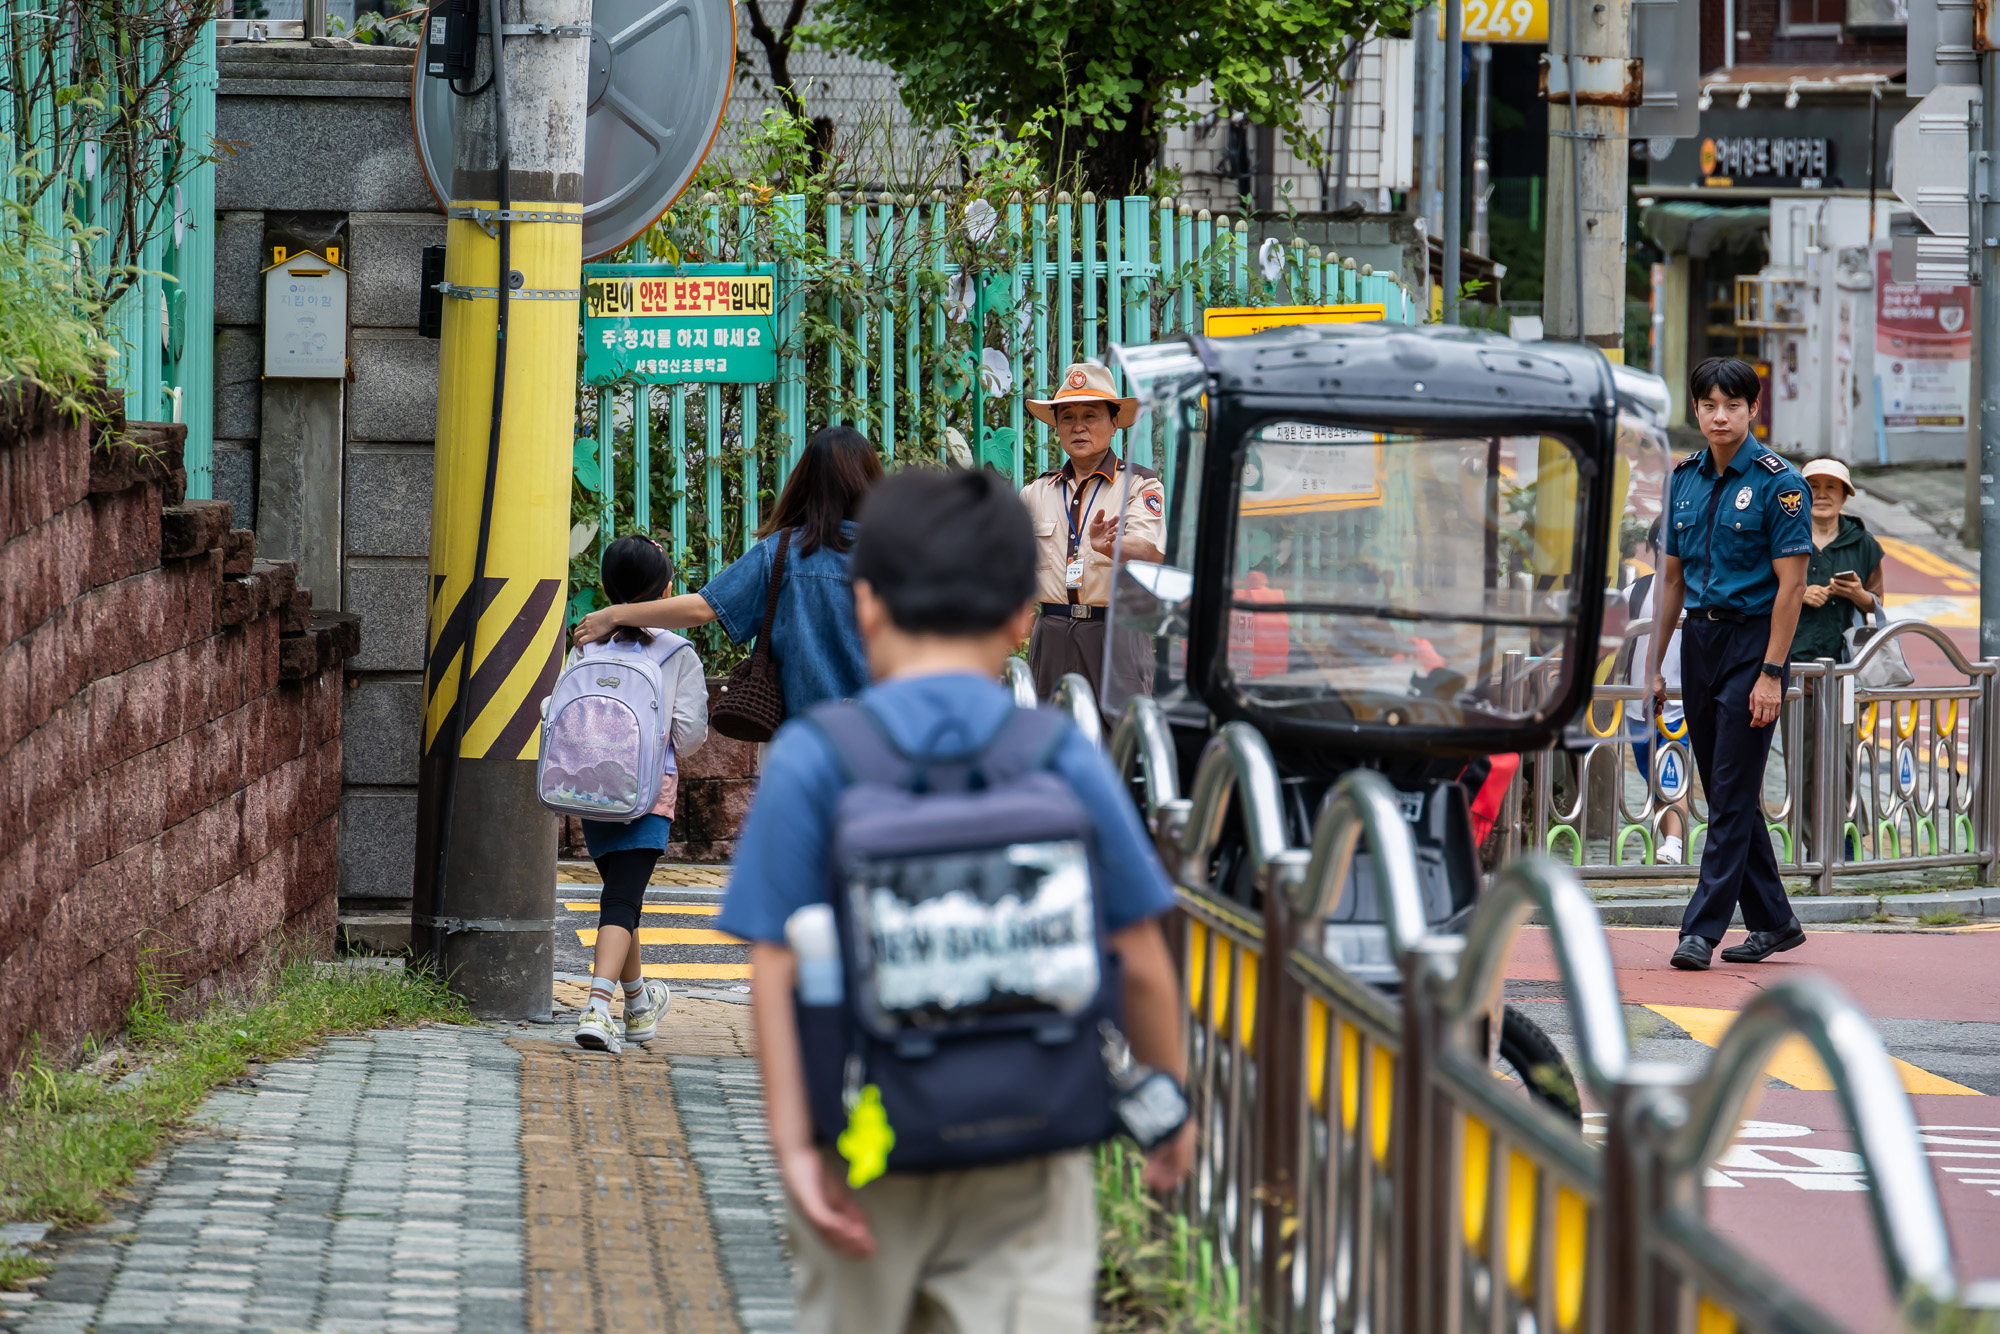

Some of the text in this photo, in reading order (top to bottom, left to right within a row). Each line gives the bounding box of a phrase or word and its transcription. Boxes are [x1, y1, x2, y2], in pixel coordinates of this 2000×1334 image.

[1461, 0, 1534, 36] 249
[640, 281, 667, 312] 안전
[674, 280, 771, 311] 보호구역입니다
[602, 327, 761, 350] 주·정차를 하지 마세요
[635, 358, 727, 374] 서울연신초등학교
[1277, 426, 1297, 440] 지정된
[1299, 425, 1312, 440] 긴급
